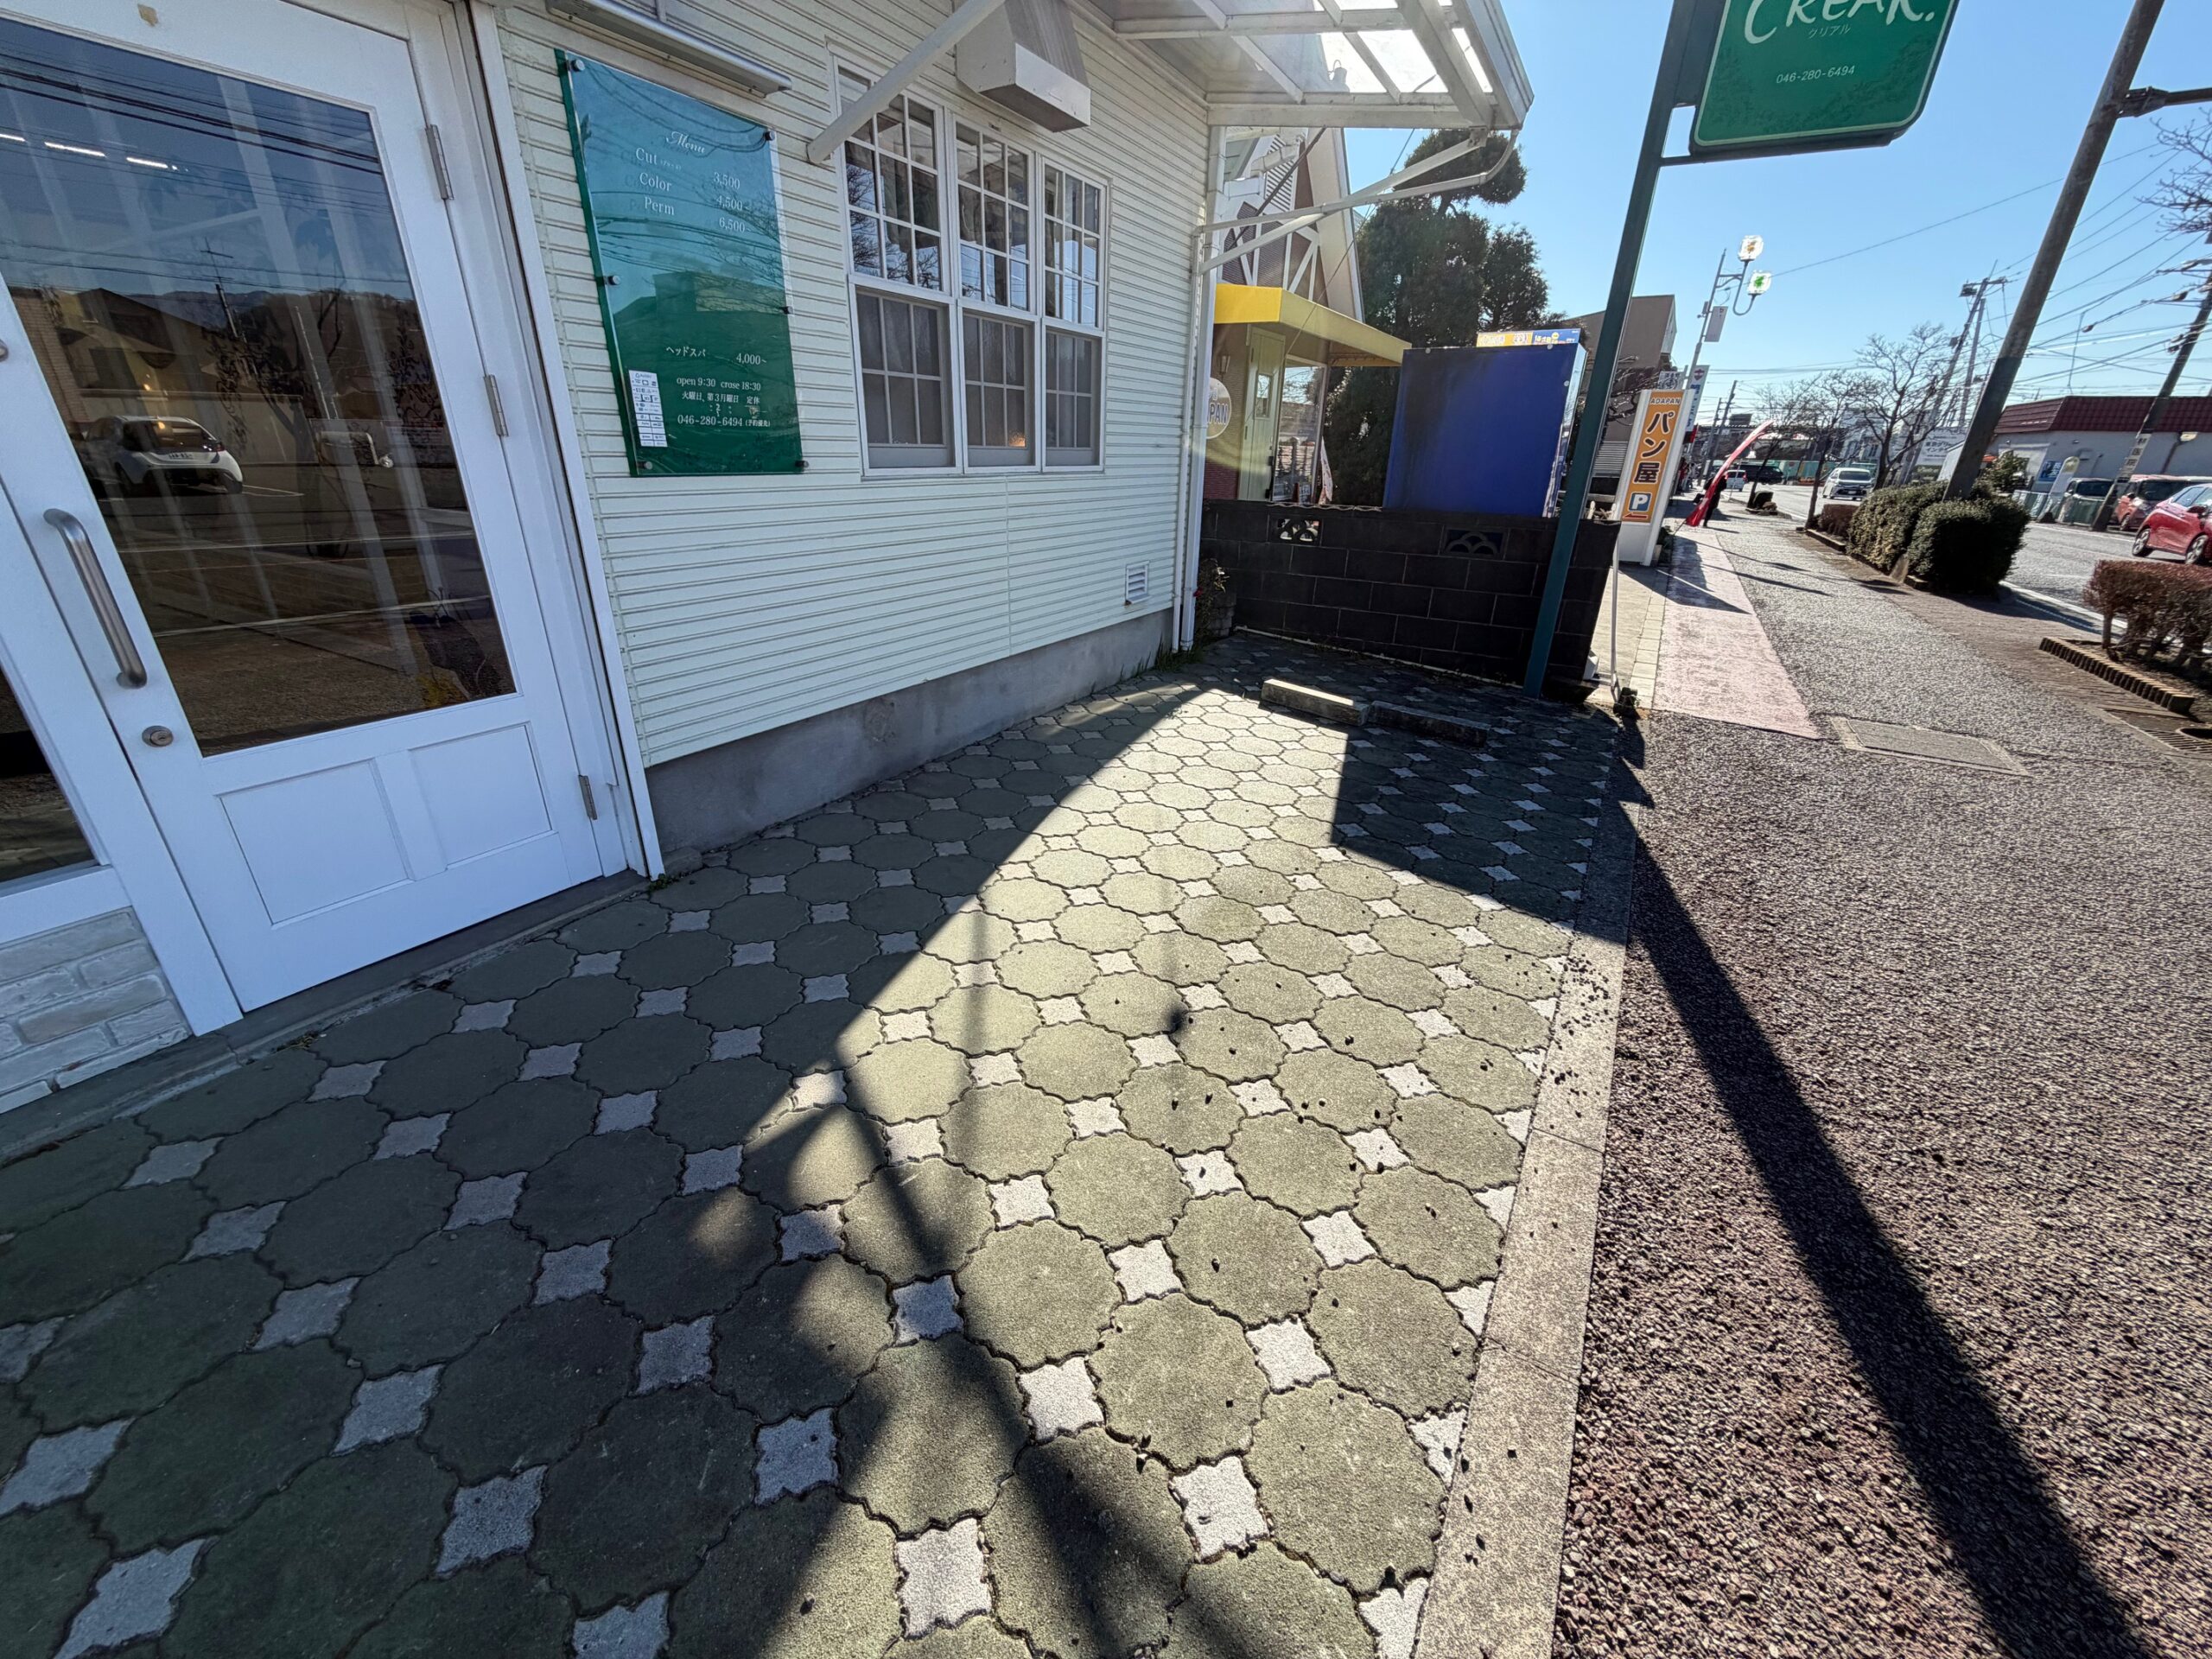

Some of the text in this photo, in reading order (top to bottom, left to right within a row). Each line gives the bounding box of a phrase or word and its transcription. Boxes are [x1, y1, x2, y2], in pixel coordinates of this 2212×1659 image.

[1808, 23, 1851, 39] クリアル
[1776, 65, 1856, 84] 046-280-6494
[665, 130, 706, 154] Menu
[636, 147, 658, 165] Cut
[639, 172, 672, 191] Color
[644, 196, 675, 215] Perm
[666, 346, 706, 357] ヘッドスパ
[677, 378, 696, 387] open
[697, 378, 716, 387] 9:30
[741, 382, 761, 391] 18:30
[1650, 397, 1681, 405] ADAPAN
[677, 415, 743, 427] 046-280-6494
[1633, 411, 1674, 484] パン屋
[1631, 493, 1649, 510] P
